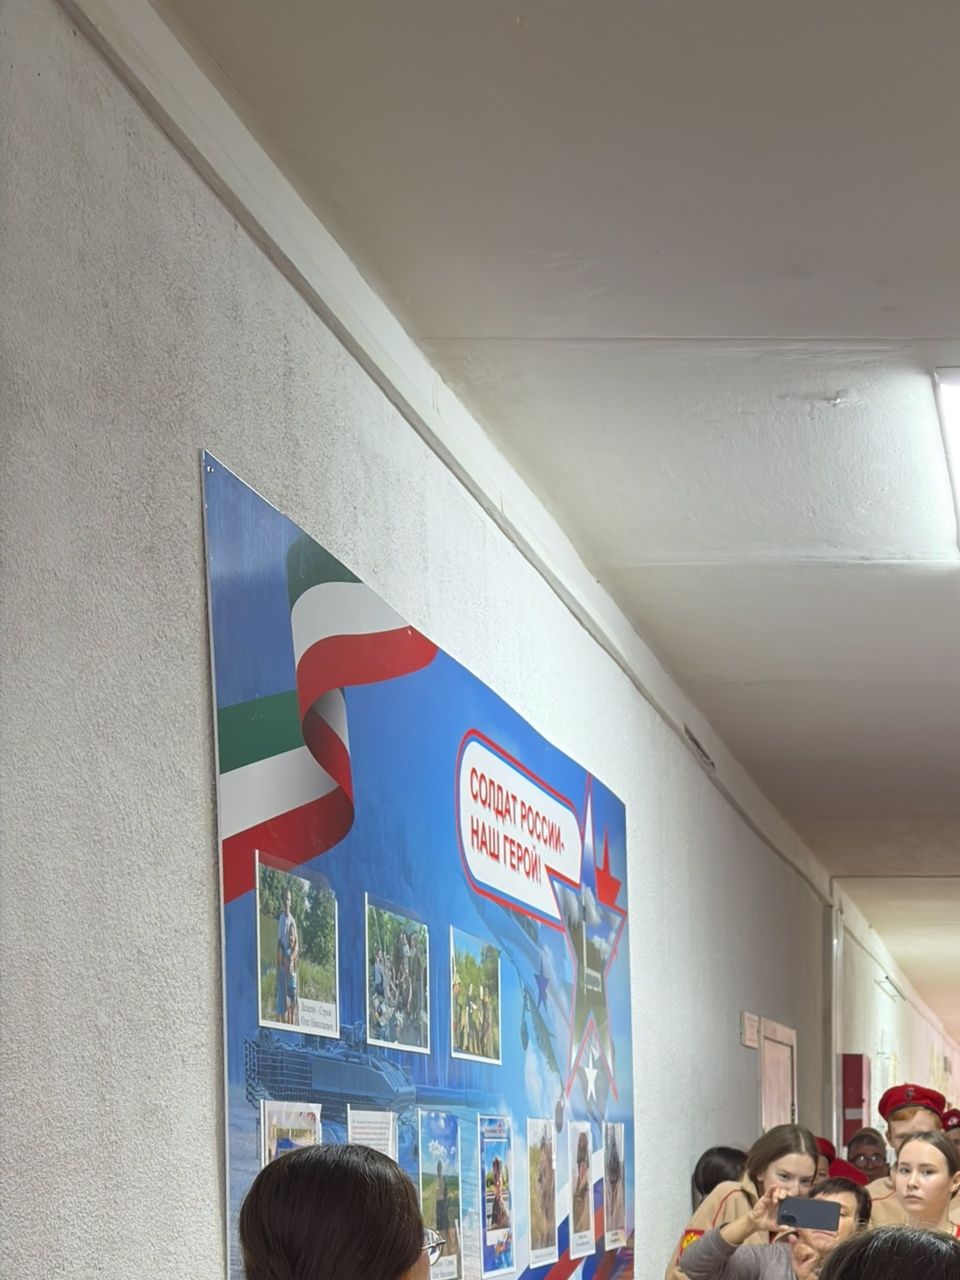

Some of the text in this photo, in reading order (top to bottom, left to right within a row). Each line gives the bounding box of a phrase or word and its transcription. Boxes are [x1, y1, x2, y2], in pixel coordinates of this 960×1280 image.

[470, 767, 517, 825] СОЛДАТ
[470, 815, 542, 885] НАШ ГЕРОЙ!
